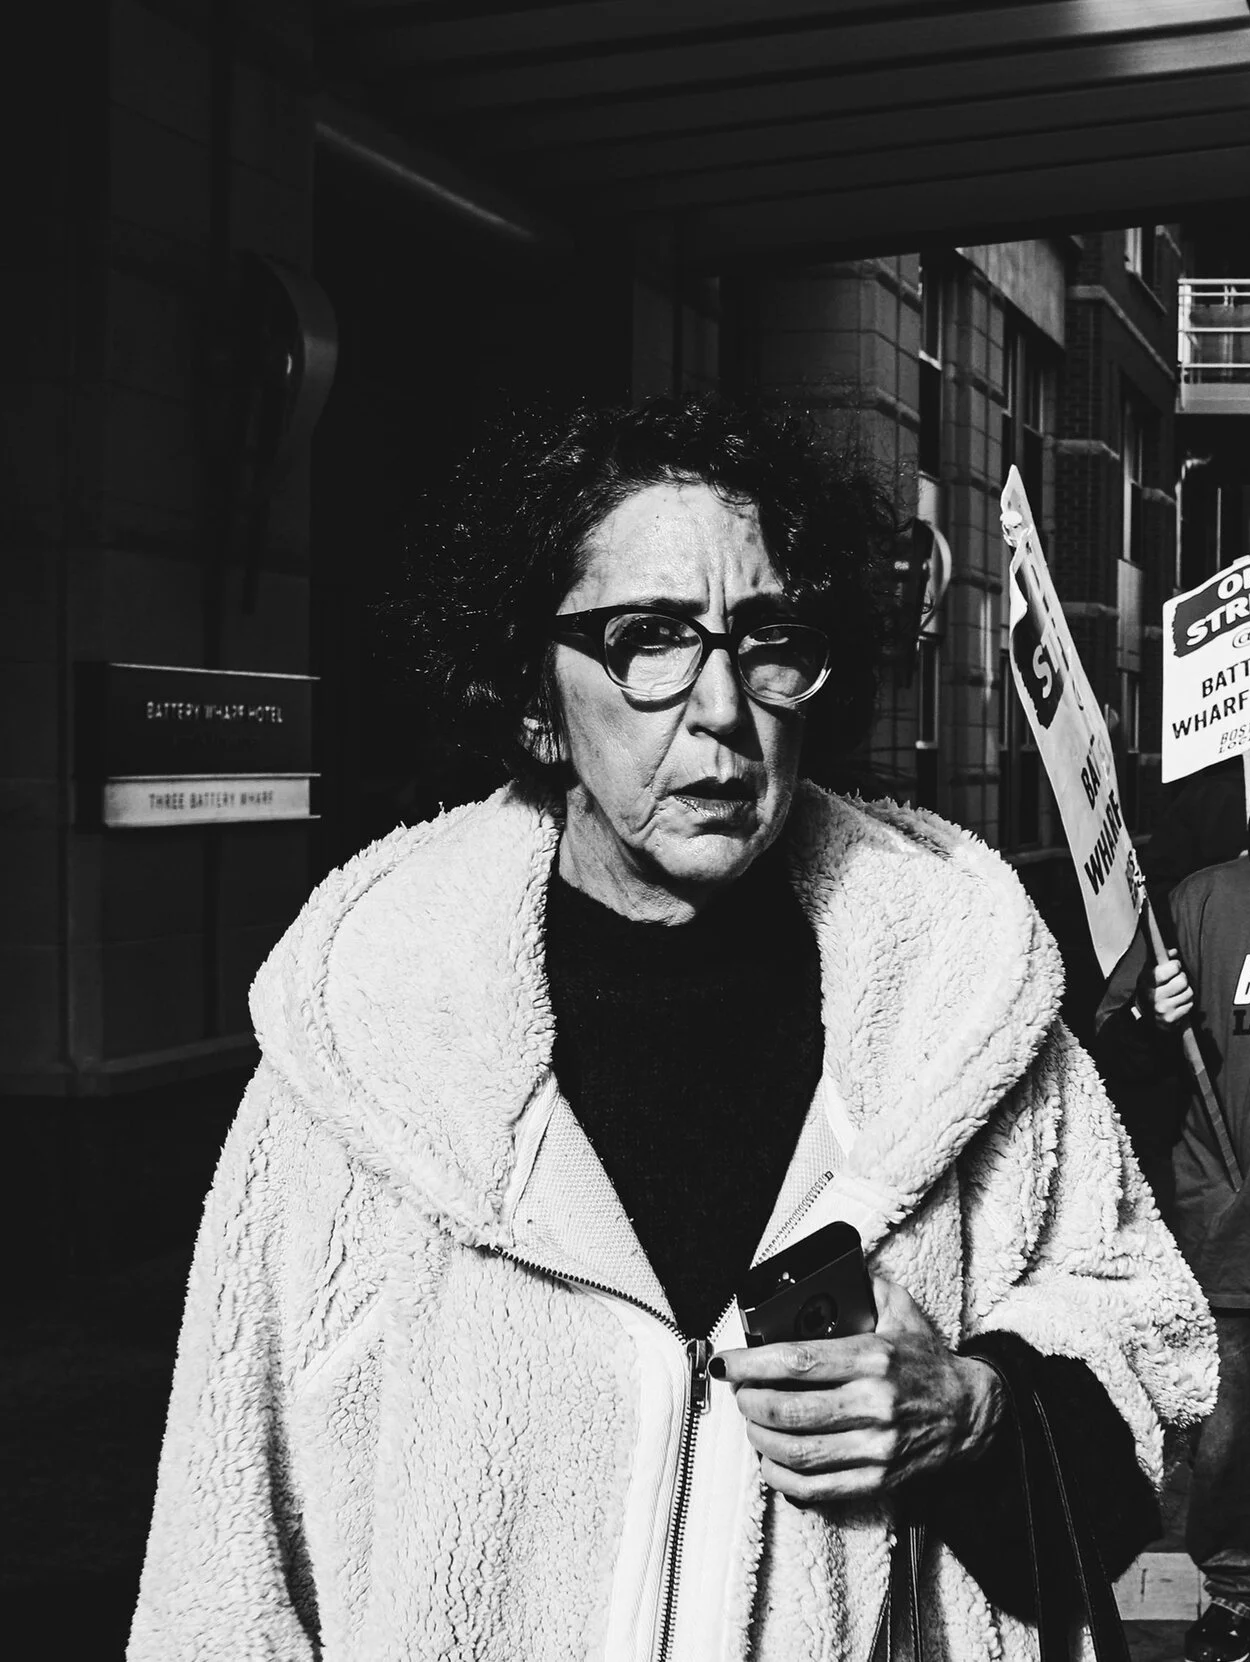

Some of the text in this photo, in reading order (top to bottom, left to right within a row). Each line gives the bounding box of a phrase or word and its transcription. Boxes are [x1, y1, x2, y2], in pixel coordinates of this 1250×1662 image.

[146, 701, 200, 720] BATTERY
[248, 705, 284, 723] HOTEL
[1172, 689, 1250, 740] WHARF
[1084, 788, 1123, 895] WHARF
